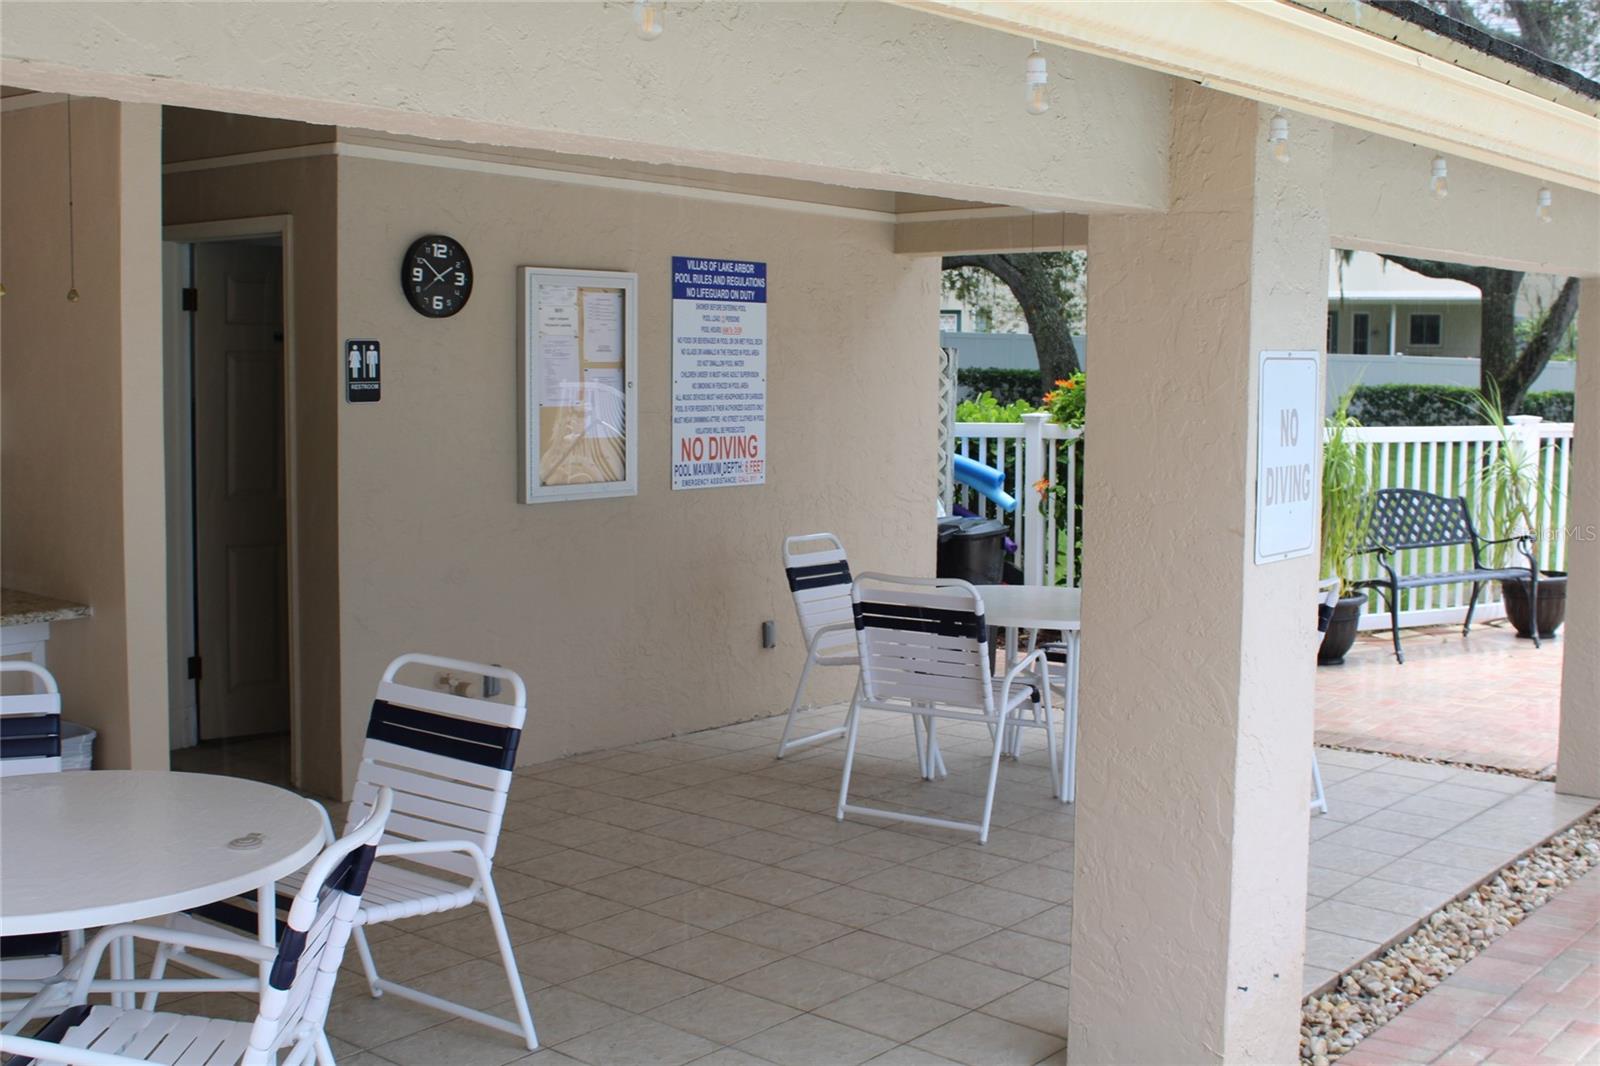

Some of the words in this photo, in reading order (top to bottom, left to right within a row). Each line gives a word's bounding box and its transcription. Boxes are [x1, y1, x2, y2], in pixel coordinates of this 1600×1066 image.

[432, 244, 447, 258] 12
[687, 260, 708, 270] VILLAS
[709, 261, 718, 271] OF
[718, 262, 733, 272] LAKE
[734, 264, 755, 273] ARBOR
[412, 268, 423, 281] 9
[454, 272, 465, 286] 3
[675, 273, 692, 283] POOL
[693, 274, 712, 284] RULES
[713, 275, 725, 285] AND
[726, 276, 765, 288] REGULATIONS
[686, 288, 695, 297] NO
[697, 288, 729, 298] LIFEGUARD
[730, 290, 739, 299] ON
[740, 290, 755, 300] DUTY
[433, 296, 443, 309] 6
[1280, 408, 1299, 447] NO
[681, 437, 703, 461] NO
[709, 435, 758, 460] DIVING
[675, 464, 691, 476] POOL
[693, 463, 721, 475] MAXIMUM
[750, 460, 763, 472] FEET
[1266, 464, 1310, 506] DIVING
